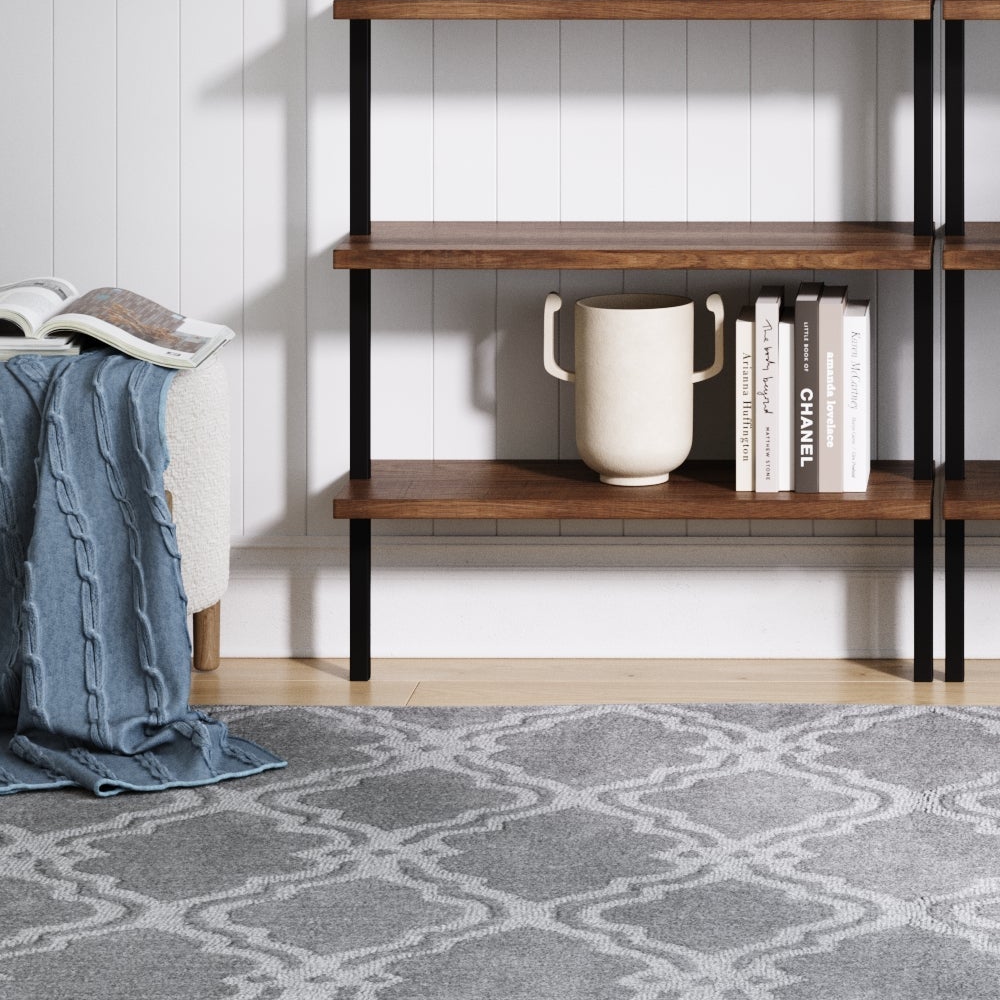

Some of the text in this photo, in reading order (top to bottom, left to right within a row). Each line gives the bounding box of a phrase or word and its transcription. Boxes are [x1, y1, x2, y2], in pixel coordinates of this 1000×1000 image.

[757, 319, 775, 414] The body beyond
[803, 363, 809, 372] OF
[851, 331, 861, 360] Karen
[741, 352, 753, 462] Arianna Huffington
[799, 387, 814, 468] CHANEL
[826, 352, 837, 448] amanda lovelace
